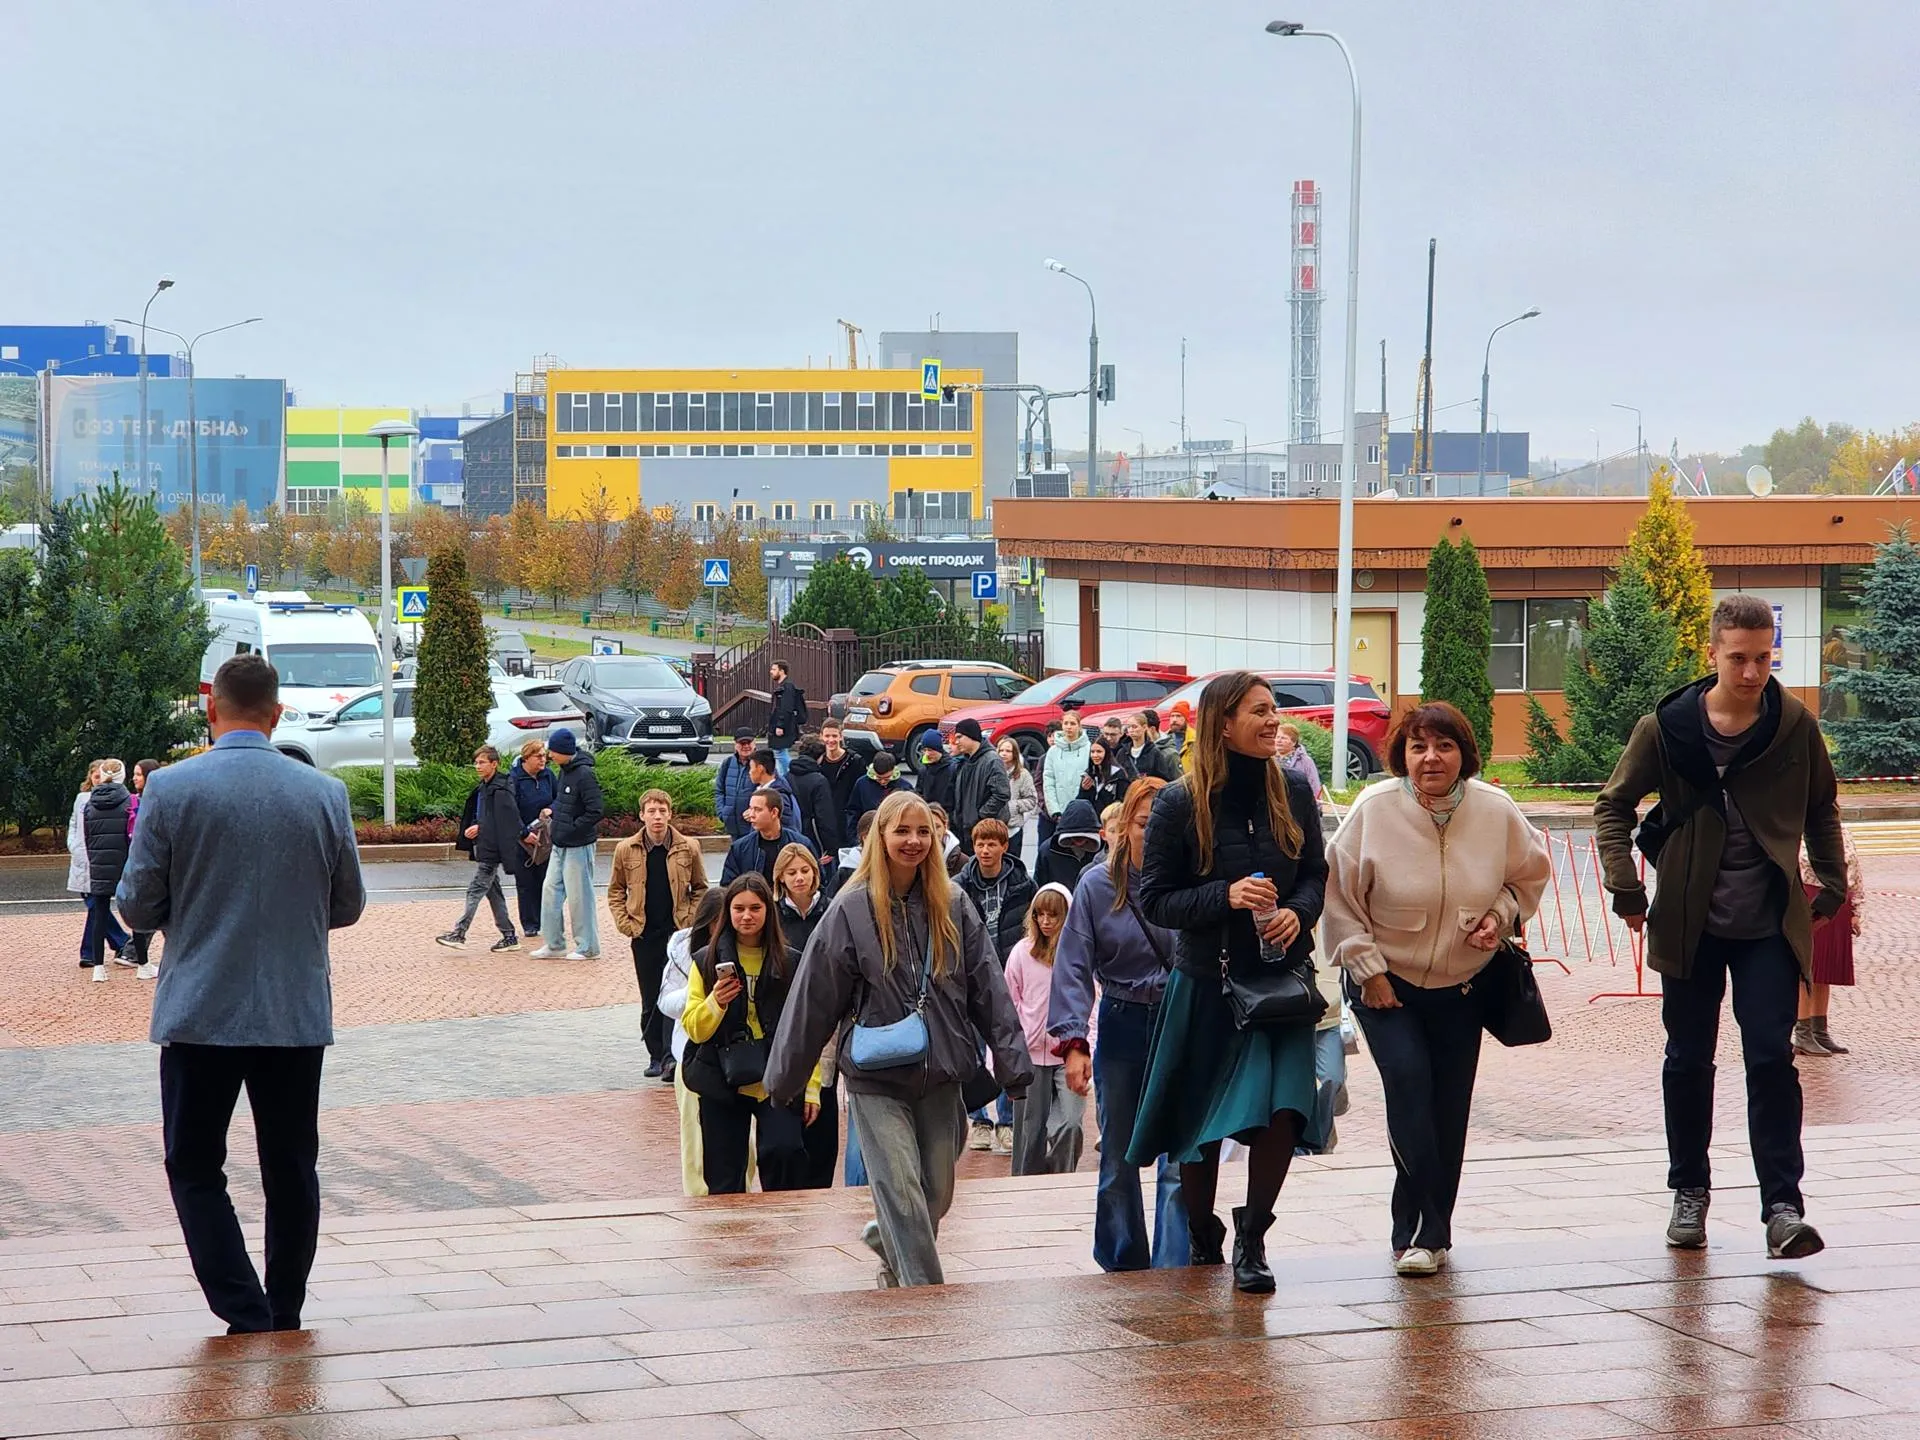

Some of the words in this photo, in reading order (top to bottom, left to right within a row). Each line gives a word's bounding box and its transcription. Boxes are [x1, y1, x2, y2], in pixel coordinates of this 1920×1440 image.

[122, 461, 164, 472] РОТА
[888, 555, 927, 566] ОФИС
[928, 555, 985, 567] ПРОДАЖ
[977, 574, 992, 596] P
